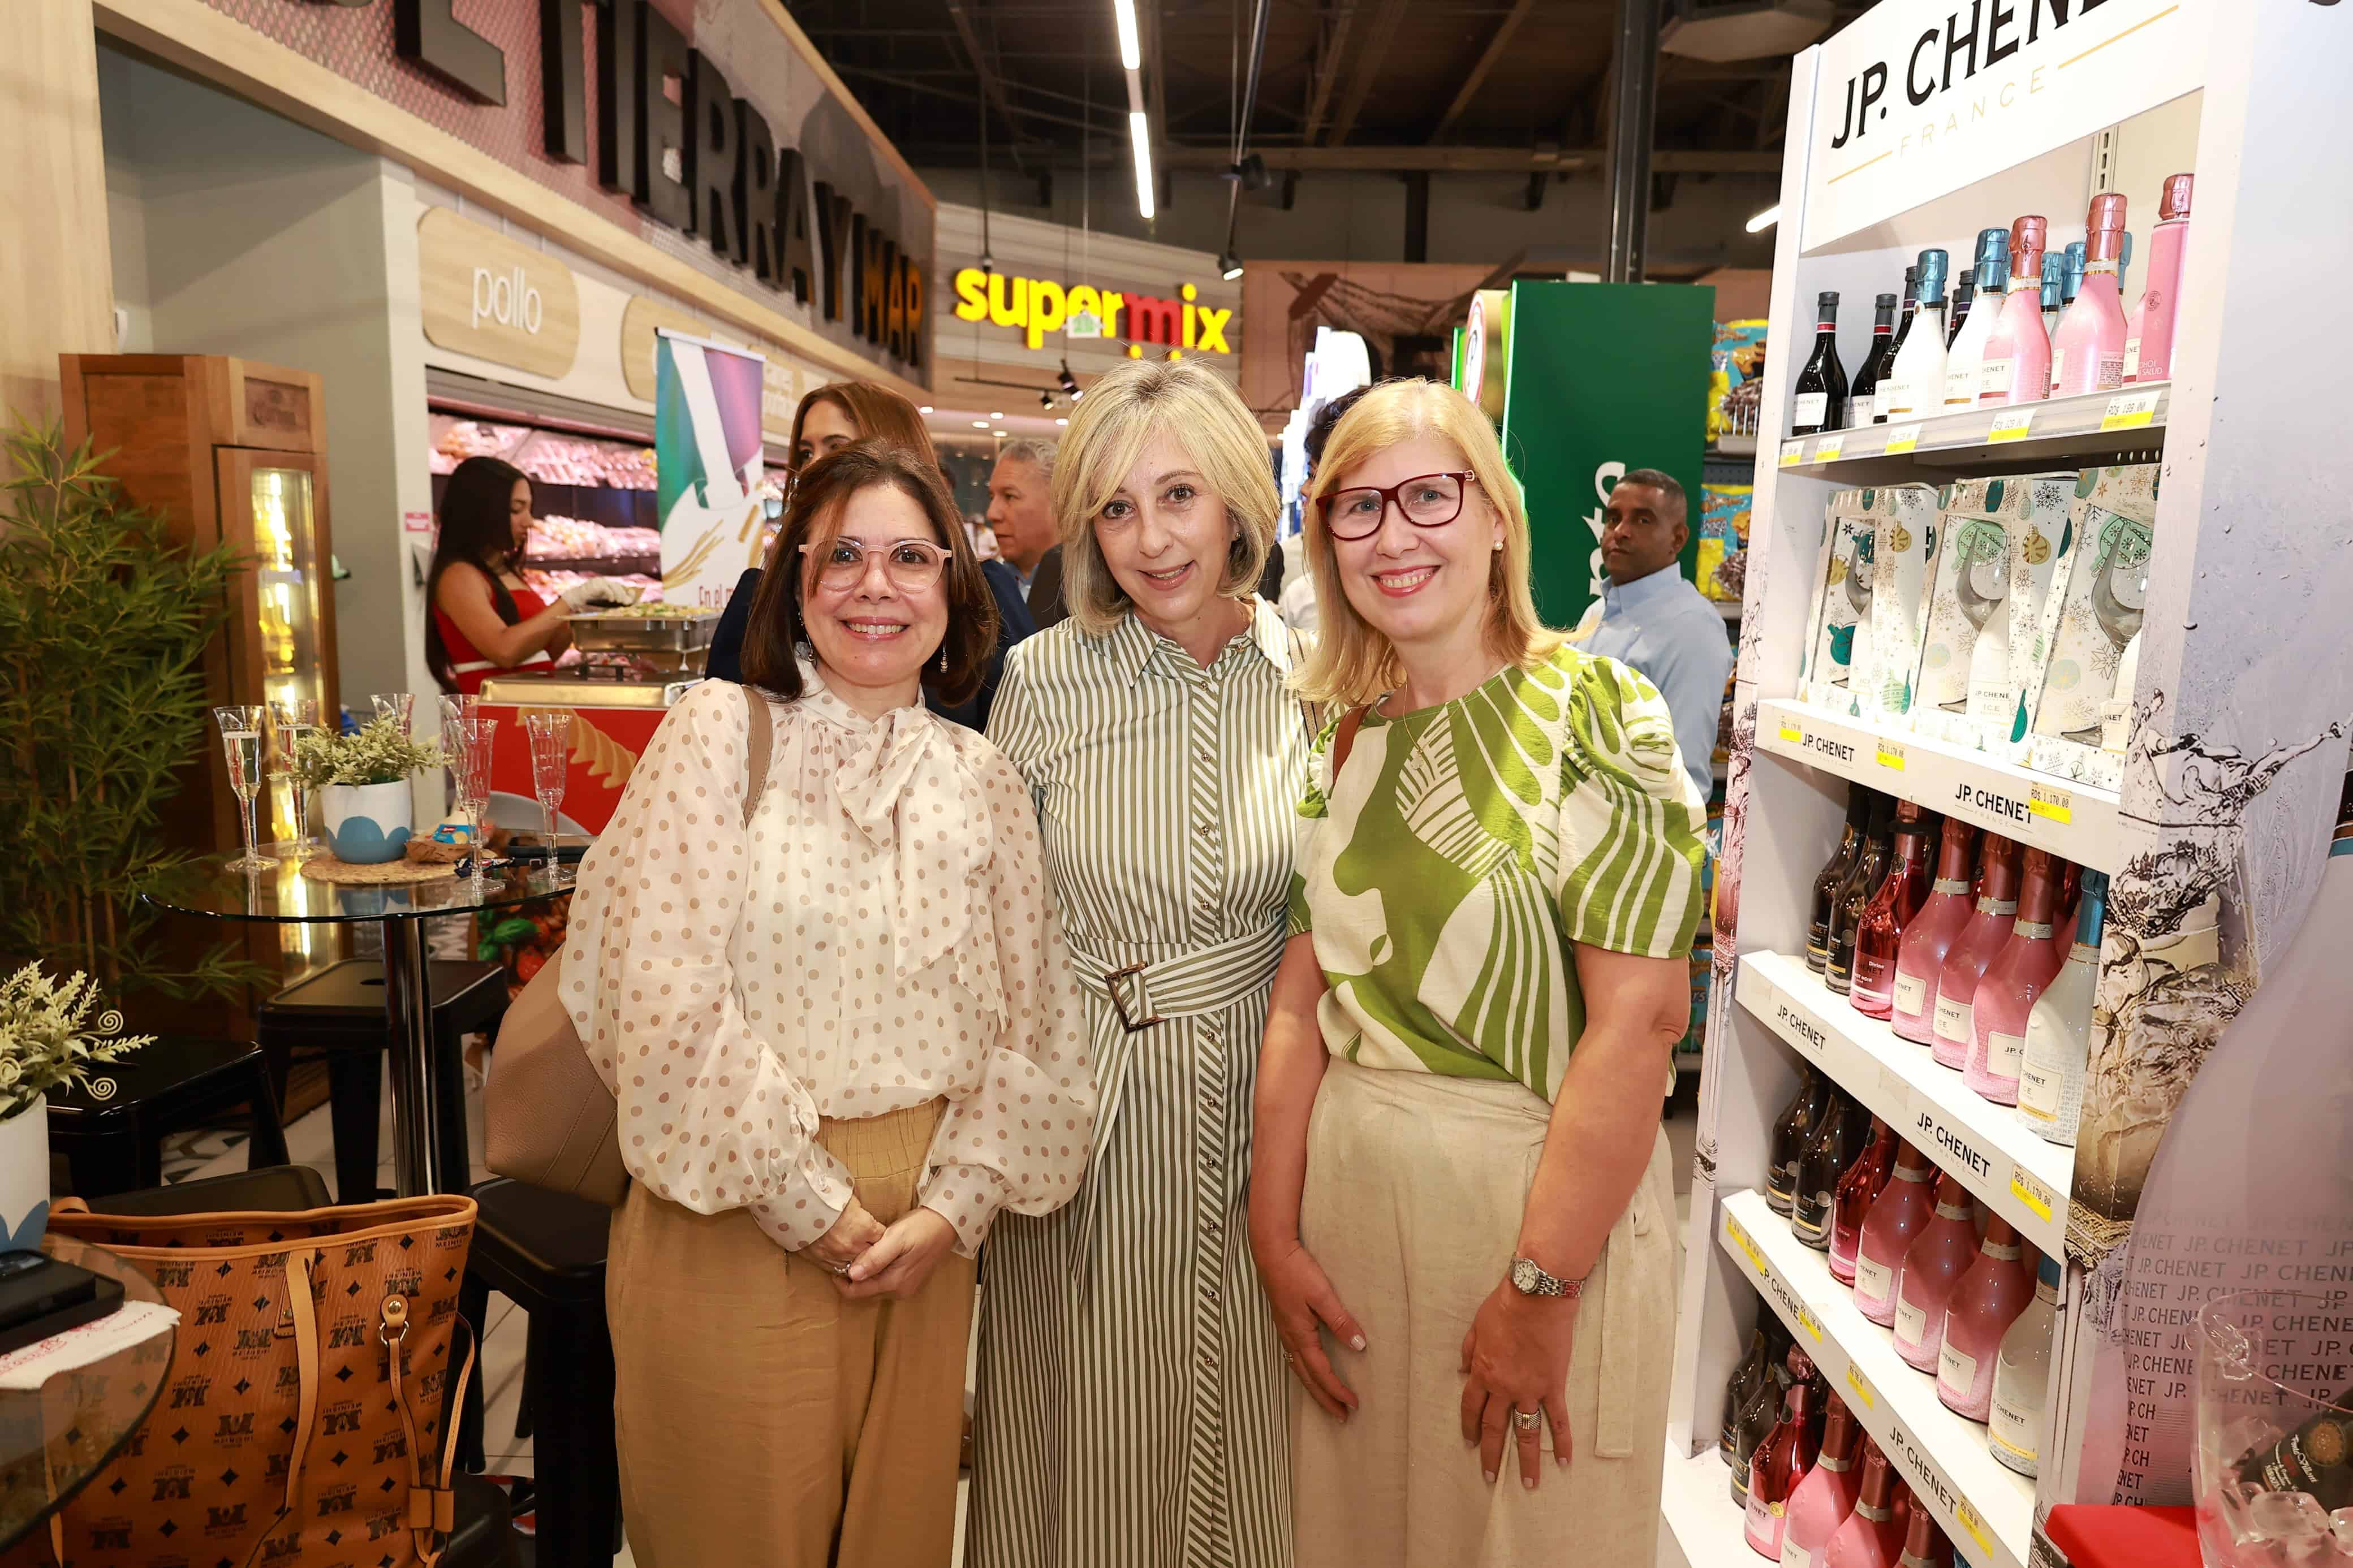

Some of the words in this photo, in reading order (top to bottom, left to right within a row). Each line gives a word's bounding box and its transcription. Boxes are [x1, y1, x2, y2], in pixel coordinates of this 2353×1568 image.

[1831, 61, 1888, 149] JP.
[1900, 64, 2046, 158] FRANCE
[472, 266, 542, 335] pollo
[956, 268, 1232, 354] supermix
[699, 585, 712, 608] En
[1984, 690, 2010, 699] CHENE
[1983, 703, 2000, 712] ICE
[1802, 733, 1814, 748] JP.
[1816, 737, 1855, 762] CHENET
[1955, 783, 1972, 802] JP.
[1976, 790, 2031, 824] CHENET
[2031, 788, 2041, 801] RD$
[2043, 792, 2070, 809] 1,170.00
[1868, 961, 1885, 969] Divine
[1777, 1004, 1788, 1021] JP.
[1790, 1013, 1826, 1050] CHENET
[1917, 1112, 1933, 1135] JP.
[1936, 1126, 1991, 1177] CHENET
[2026, 1181, 2052, 1208] 1,170.00
[2184, 1235, 2206, 1252] JP.
[2213, 1237, 2308, 1256] CHENET
[1760, 1267, 1770, 1284] P.
[2137, 1257, 2151, 1273] JP.
[2154, 1258, 2227, 1278] CHENET
[2240, 1264, 2269, 1280] JP.
[2124, 1280, 2168, 1301] CHENET
[2177, 1285, 2200, 1301] JP.
[2207, 1286, 2302, 1308] CHENET
[2131, 1306, 2145, 1321] JP.
[2311, 1341, 2341, 1357] JP.
[2128, 1353, 2140, 1369] JP.
[2164, 1381, 2187, 1398] JP.
[1996, 1403, 2026, 1425] CHENET
[1889, 1426, 1904, 1451] JP.
[1907, 1446, 1957, 1516] CHENET
